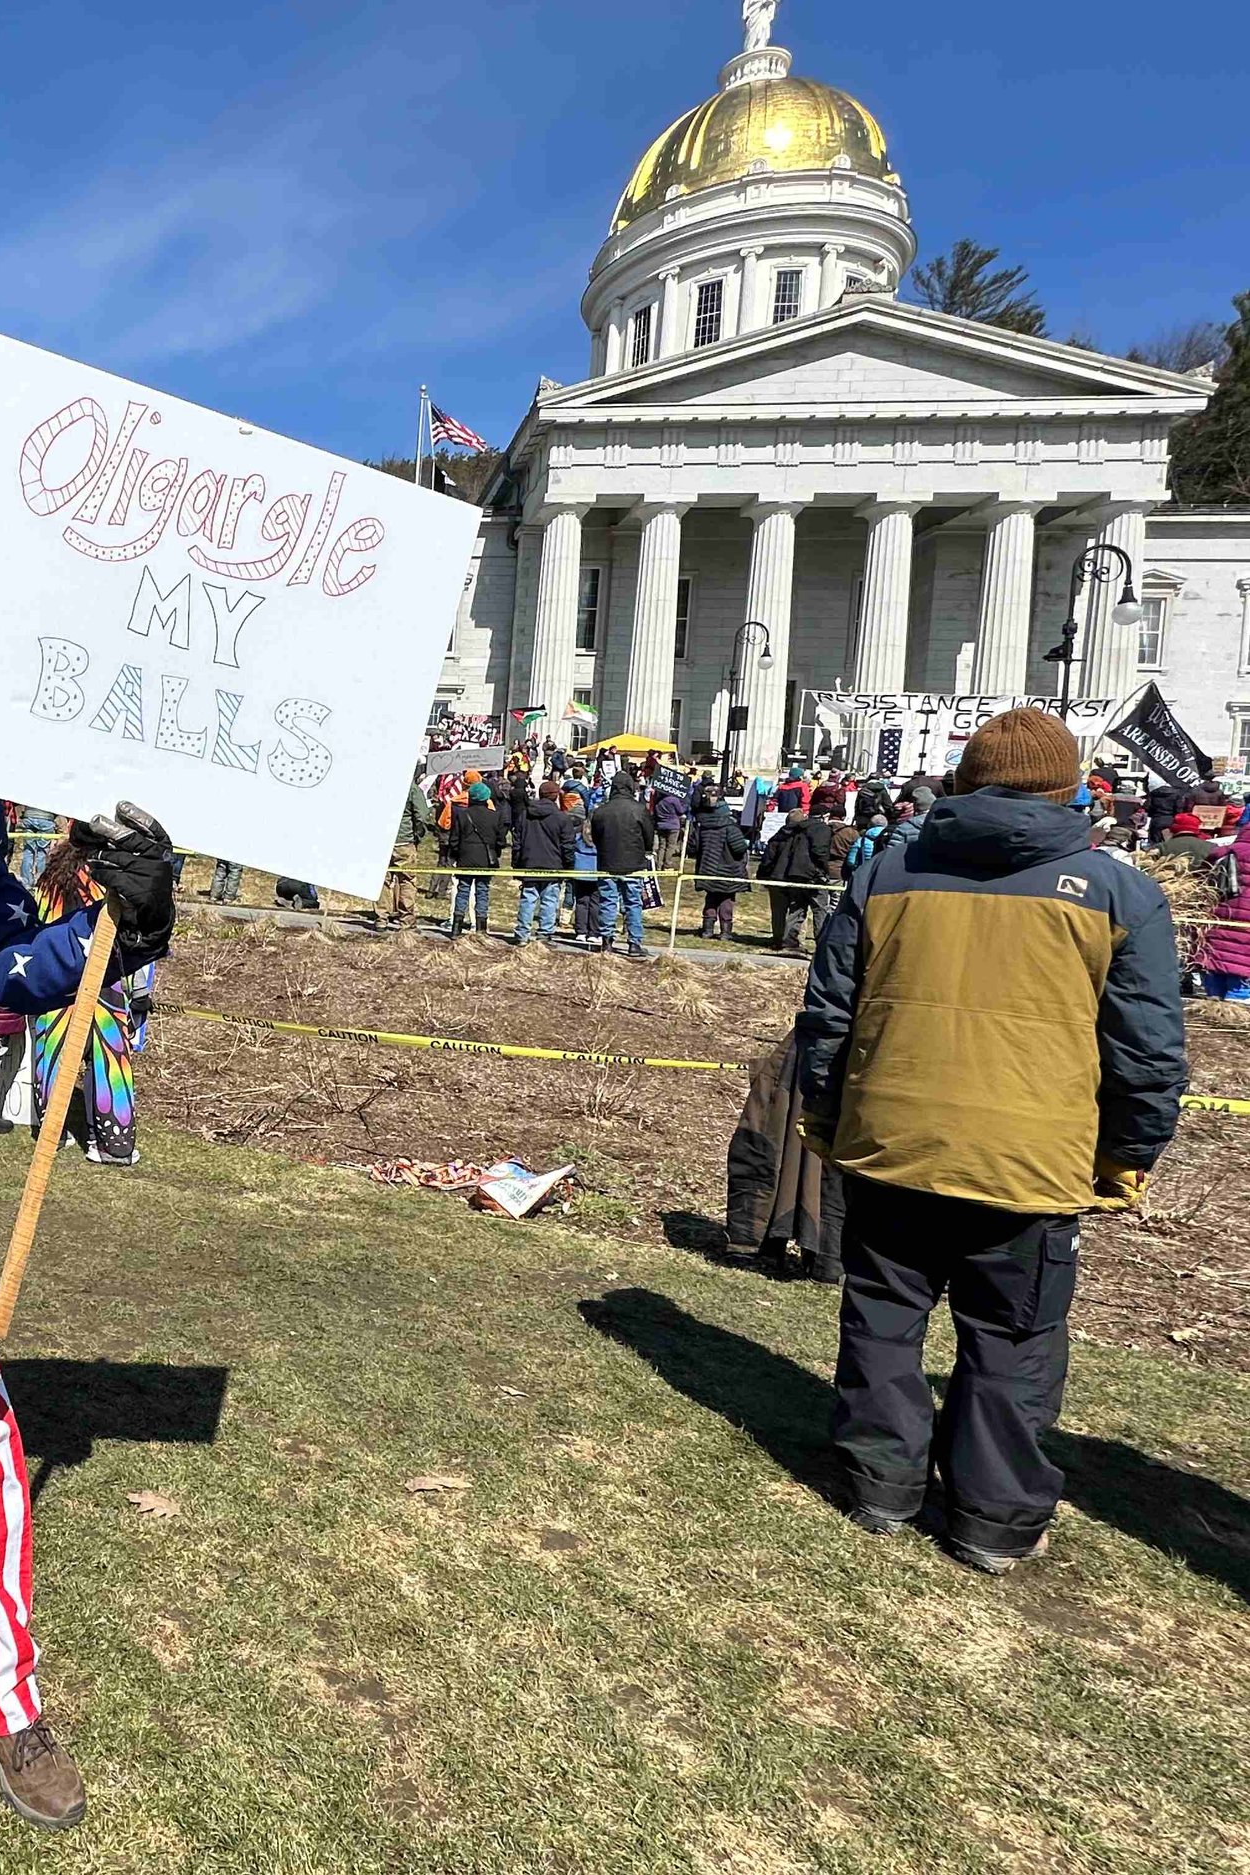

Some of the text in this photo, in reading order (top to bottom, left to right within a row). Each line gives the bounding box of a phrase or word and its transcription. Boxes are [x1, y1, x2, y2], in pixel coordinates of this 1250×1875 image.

[19, 397, 385, 597] Oligargle
[127, 565, 267, 668] MY
[30, 636, 333, 788] BALLS
[1119, 724, 1150, 747] ARE
[1143, 739, 1180, 771] PISSED
[152, 1002, 187, 1015] UTION
[222, 1013, 275, 1030] CAUTION
[317, 1028, 379, 1044] CAUTION
[430, 1040, 502, 1055] CAUTION
